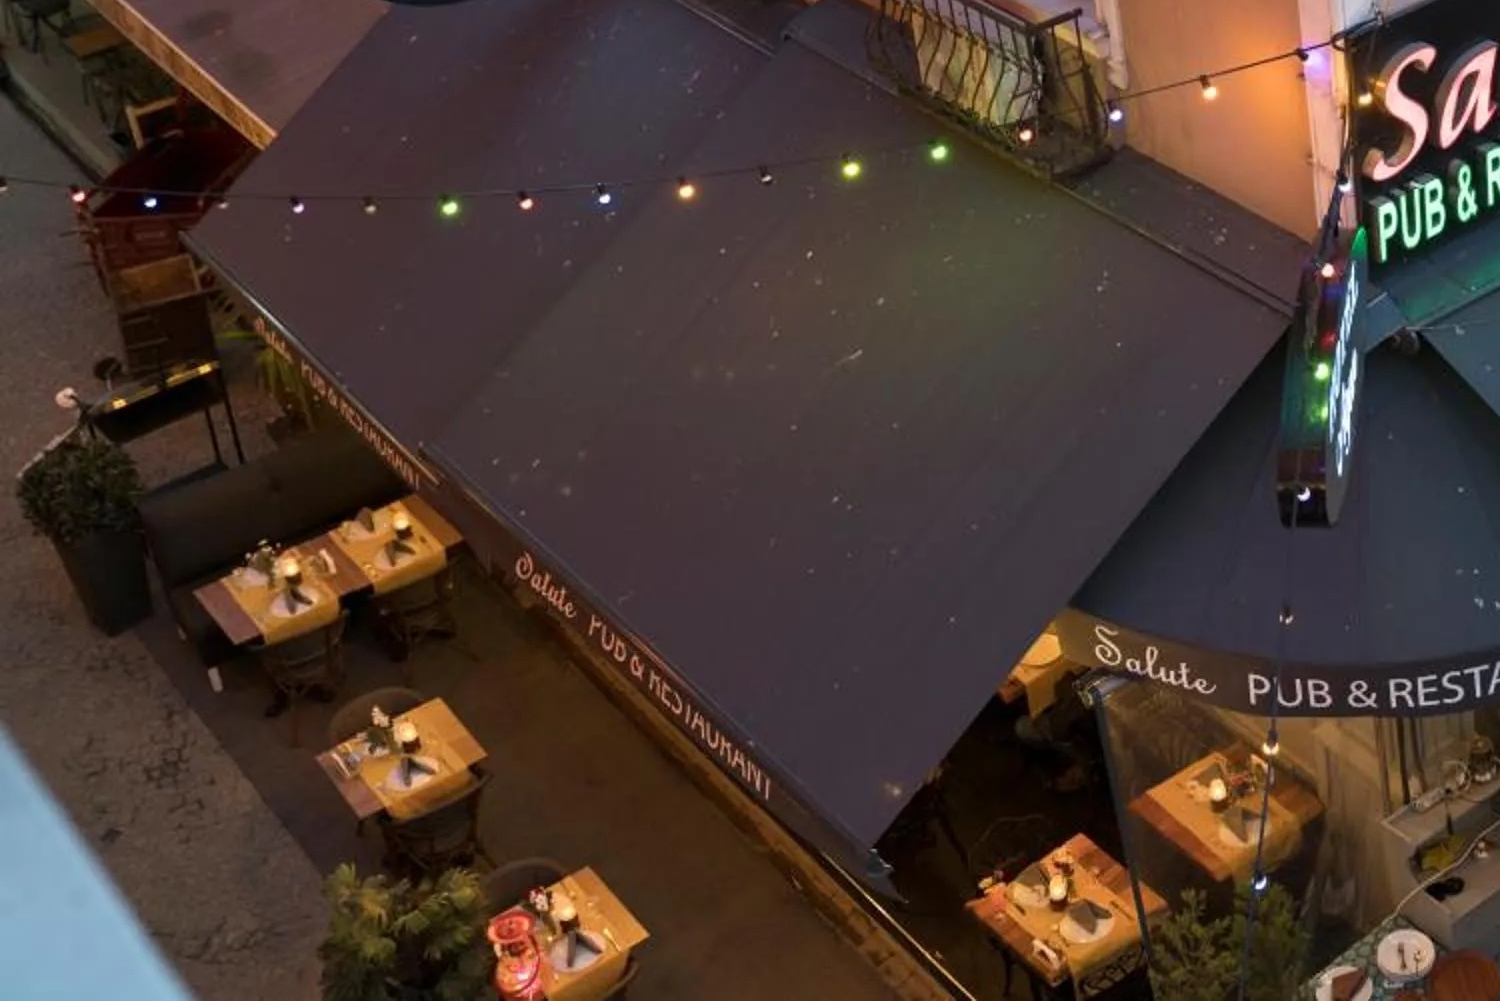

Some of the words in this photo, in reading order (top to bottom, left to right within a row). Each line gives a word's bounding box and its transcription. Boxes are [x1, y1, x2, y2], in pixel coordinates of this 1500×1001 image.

[1376, 176, 1447, 264] PUB
[1456, 163, 1478, 223] &
[1093, 624, 1217, 694] Salute
[1247, 673, 1333, 709] PUB
[1347, 680, 1379, 709] &
